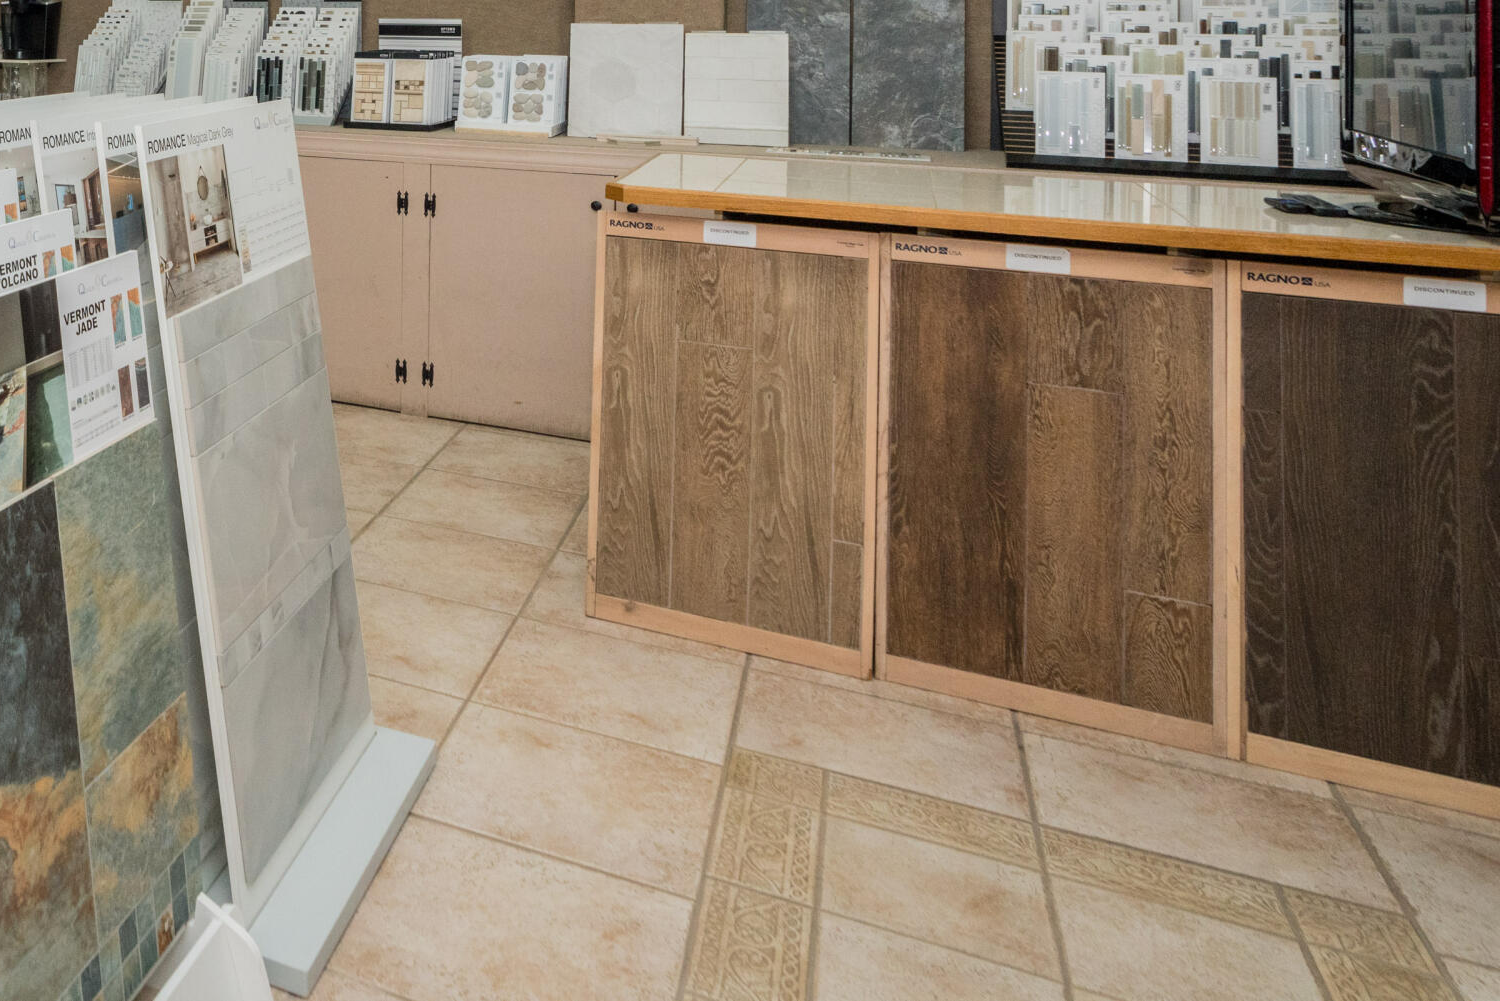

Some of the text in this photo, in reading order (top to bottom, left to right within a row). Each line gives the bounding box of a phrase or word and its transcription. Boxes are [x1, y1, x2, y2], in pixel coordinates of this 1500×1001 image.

[42, 130, 86, 150] ROMANCE
[147, 134, 187, 155] ROMANCE
[208, 127, 222, 141] Dark
[221, 126, 234, 140] Grey
[609, 219, 645, 230] RAGNO
[895, 242, 938, 255] RAGNO
[1014, 252, 1063, 262] DISCONTINUED
[1247, 271, 1331, 289] RAGNO USA
[1414, 285, 1476, 297] DISCONTINUED
[63, 299, 106, 326] VERMONT
[75, 316, 98, 336] JADE
